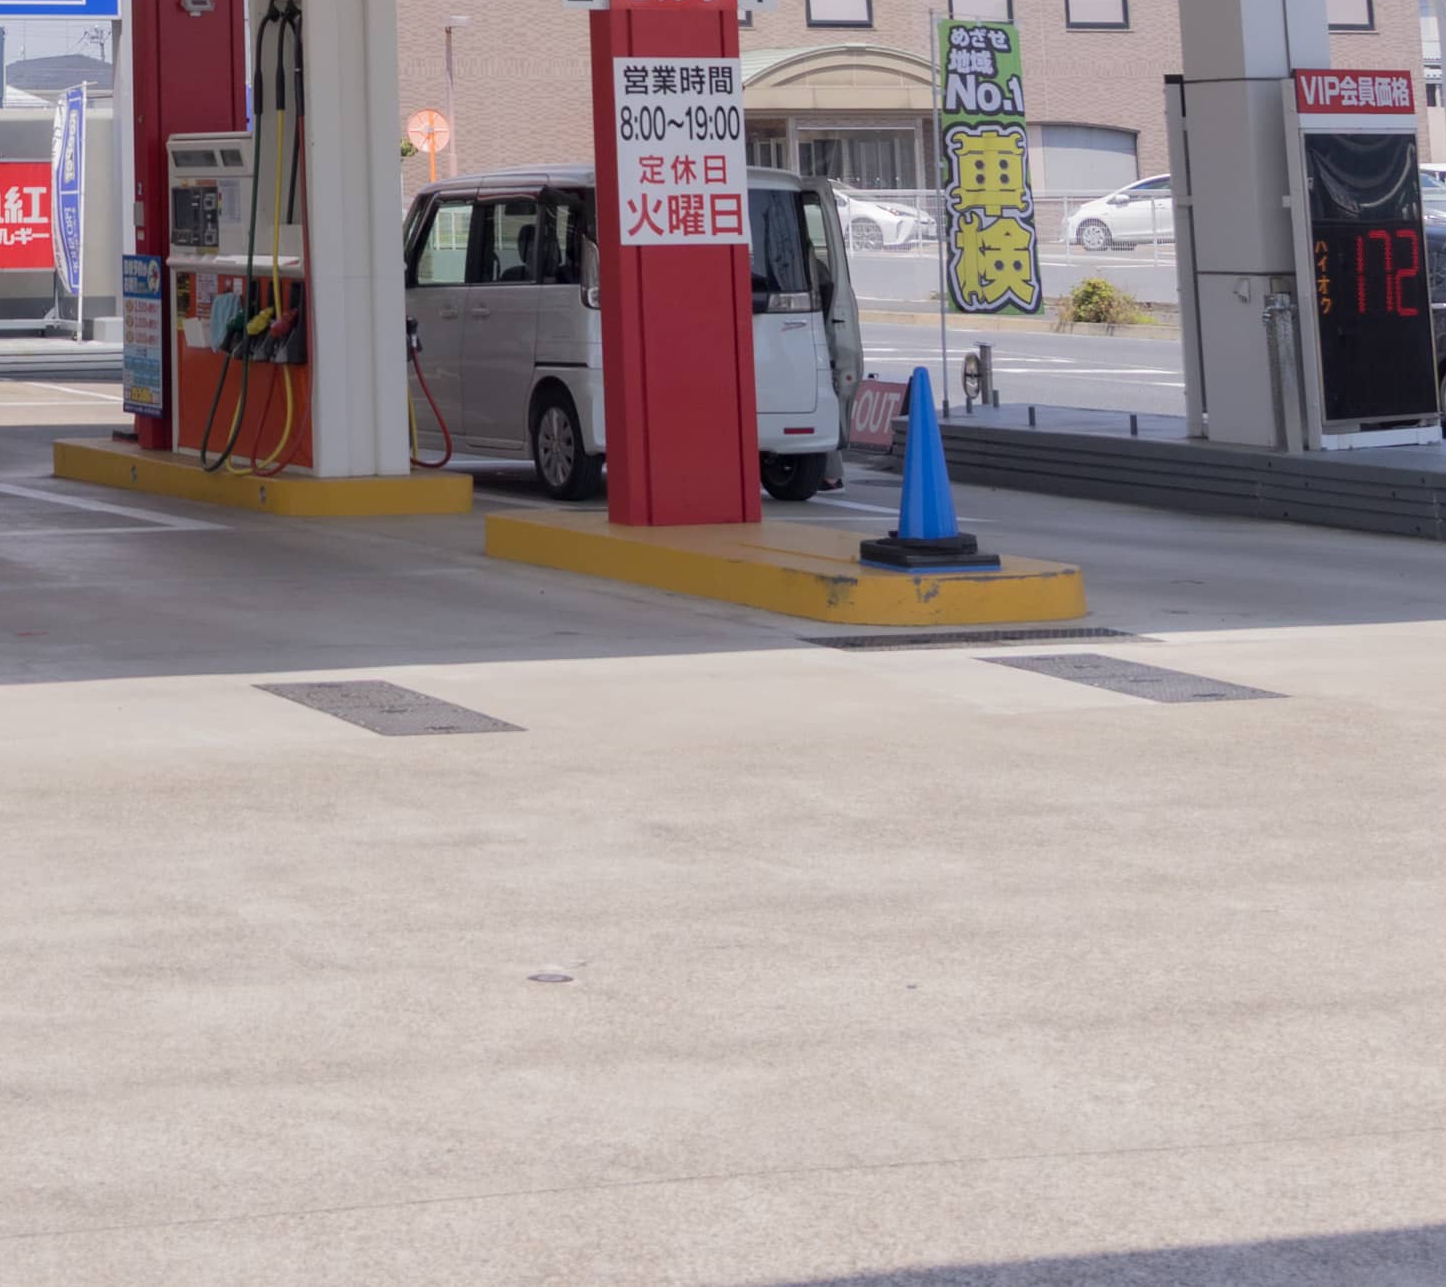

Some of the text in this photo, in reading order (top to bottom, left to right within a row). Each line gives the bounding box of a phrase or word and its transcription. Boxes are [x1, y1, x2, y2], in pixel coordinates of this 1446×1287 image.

[948, 27, 1009, 50] めざせ
[623, 65, 735, 96] 営業時間
[948, 50, 994, 75] 地域
[944, 76, 1024, 113] No.1
[1300, 75, 1410, 107] VIP会員価格
[638, 154, 728, 186] 定休日
[626, 192, 744, 238] 火曜日
[948, 129, 1039, 310] 車検
[1314, 240, 1333, 314] ハイオク
[1358, 230, 1419, 316] 172
[855, 389, 901, 434] OUT
